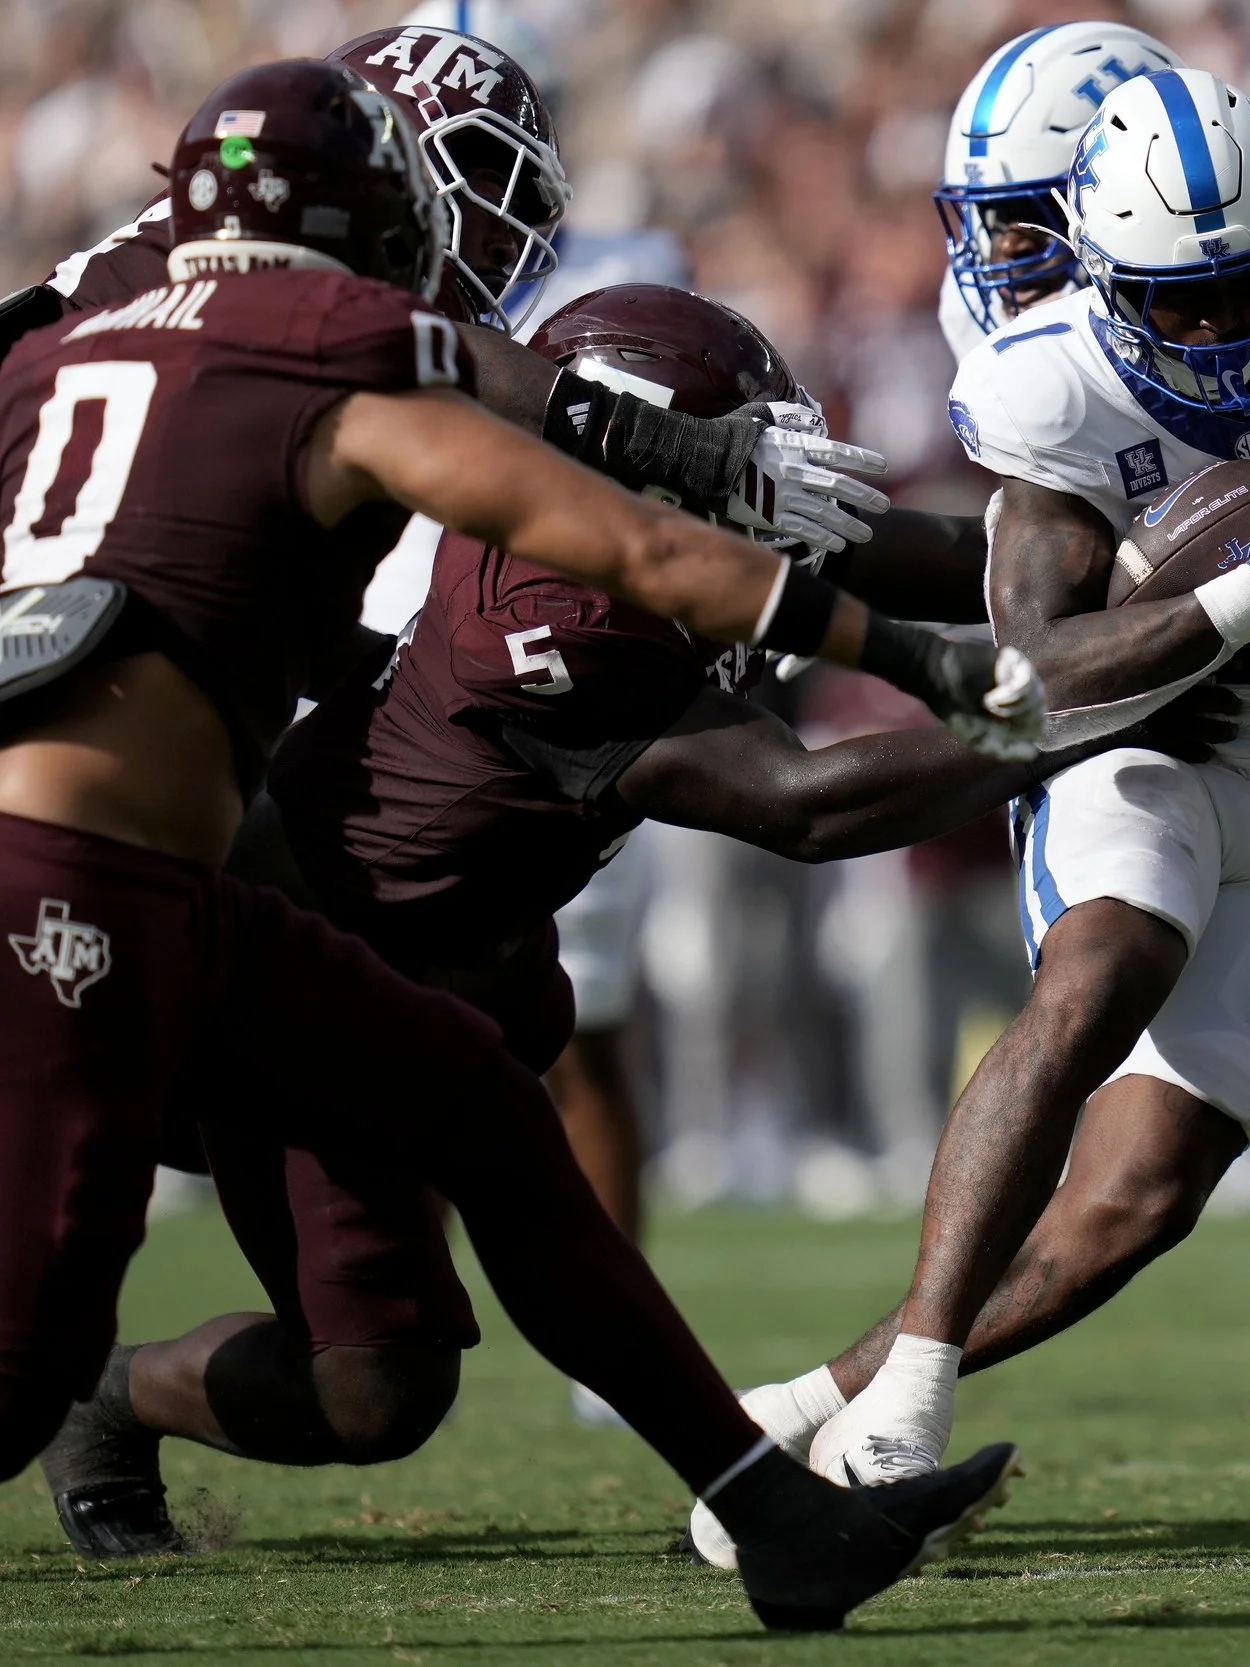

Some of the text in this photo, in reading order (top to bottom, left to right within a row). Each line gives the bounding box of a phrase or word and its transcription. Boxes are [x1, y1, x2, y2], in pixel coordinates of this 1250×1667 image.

[992, 321, 1074, 355] 1
[0, 361, 158, 593] 0
[1124, 446, 1157, 478] UK
[1129, 471, 1162, 492] INVESTS
[1166, 485, 1250, 542] VAPOR ELITE
[504, 624, 574, 695] 5
